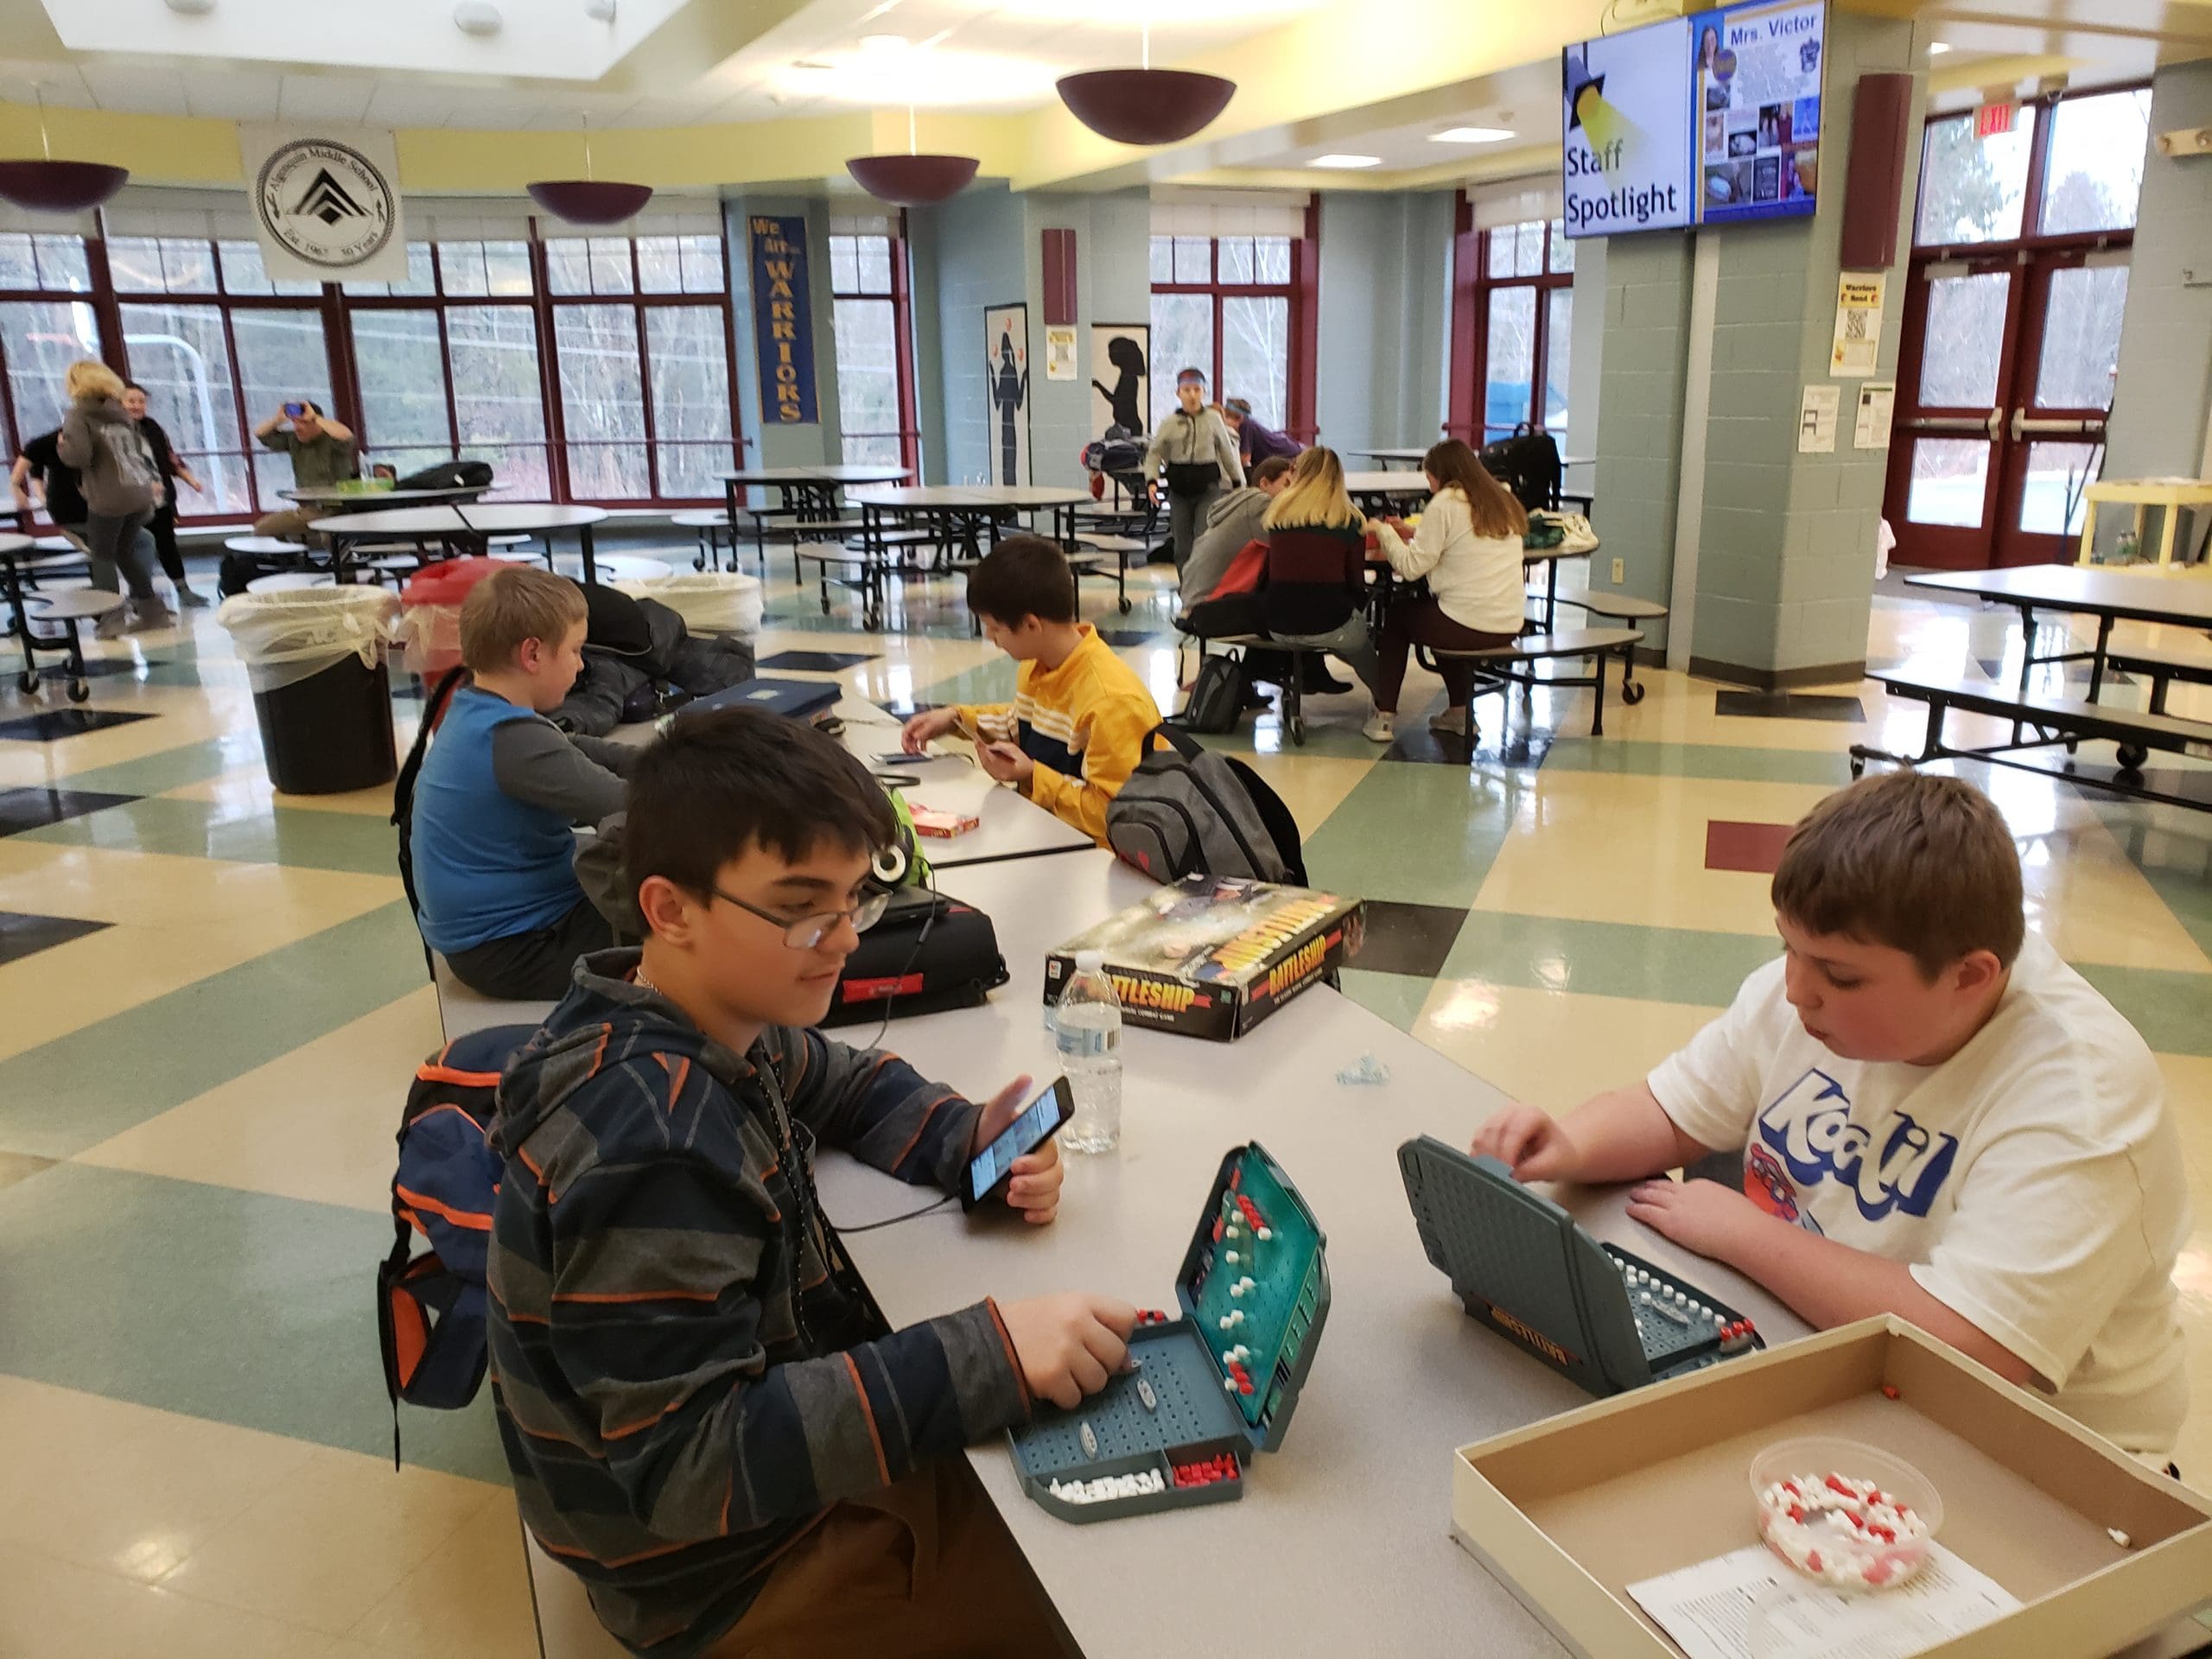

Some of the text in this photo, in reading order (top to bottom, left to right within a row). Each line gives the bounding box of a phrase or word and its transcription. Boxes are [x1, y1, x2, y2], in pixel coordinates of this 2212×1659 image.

[1731, 14, 1817, 46] Mrs. Victor
[1980, 105, 2010, 136] EXIT
[308, 147, 346, 165] Middle
[346, 160, 378, 192] School
[1567, 138, 1624, 176] Staff
[753, 218, 779, 234] We
[1567, 182, 1678, 229] Spotlight
[766, 260, 802, 423] WARRIORS
[1269, 935, 1326, 996] BATTLESHIP
[1090, 972, 1196, 1014] TTLESHIP
